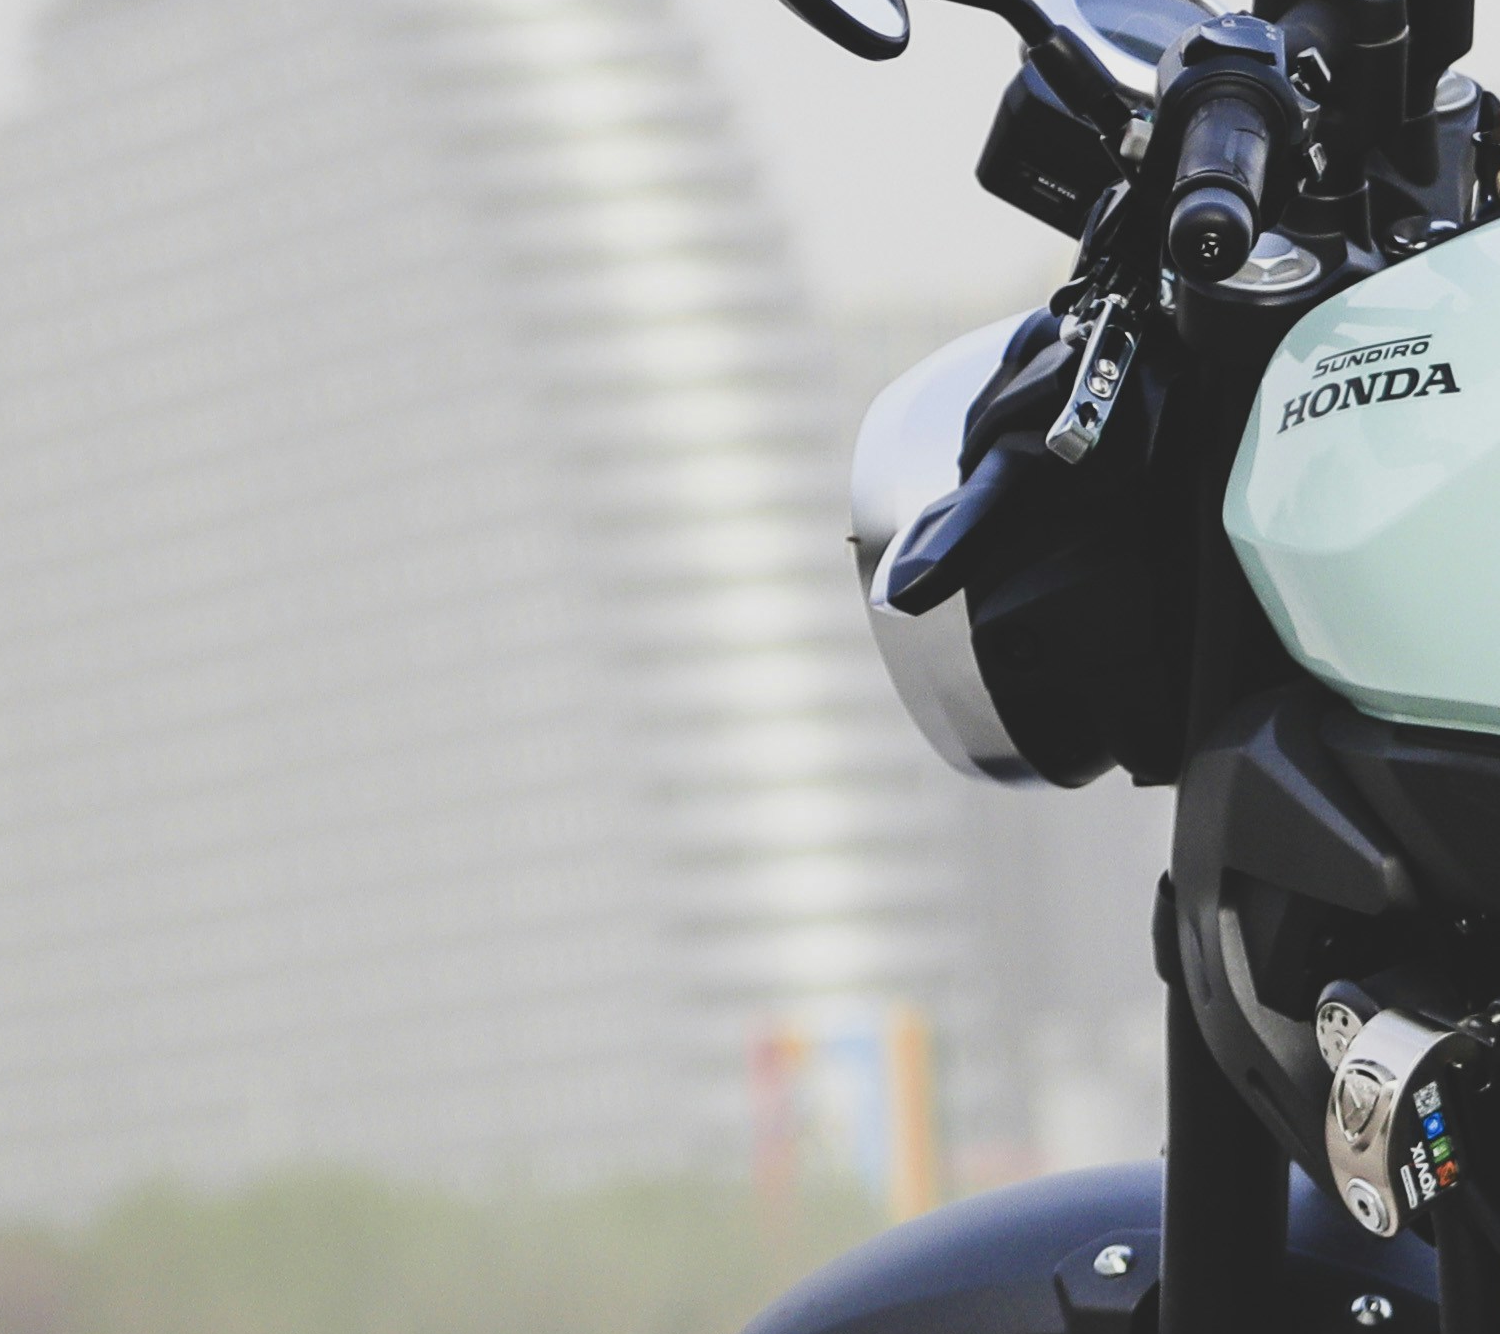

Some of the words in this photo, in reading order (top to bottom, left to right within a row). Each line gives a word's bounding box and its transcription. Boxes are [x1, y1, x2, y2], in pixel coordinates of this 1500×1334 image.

[1312, 334, 1433, 379] SUNDIRO
[1276, 362, 1461, 434] HONDA
[1409, 1141, 1438, 1201] KOVIX
